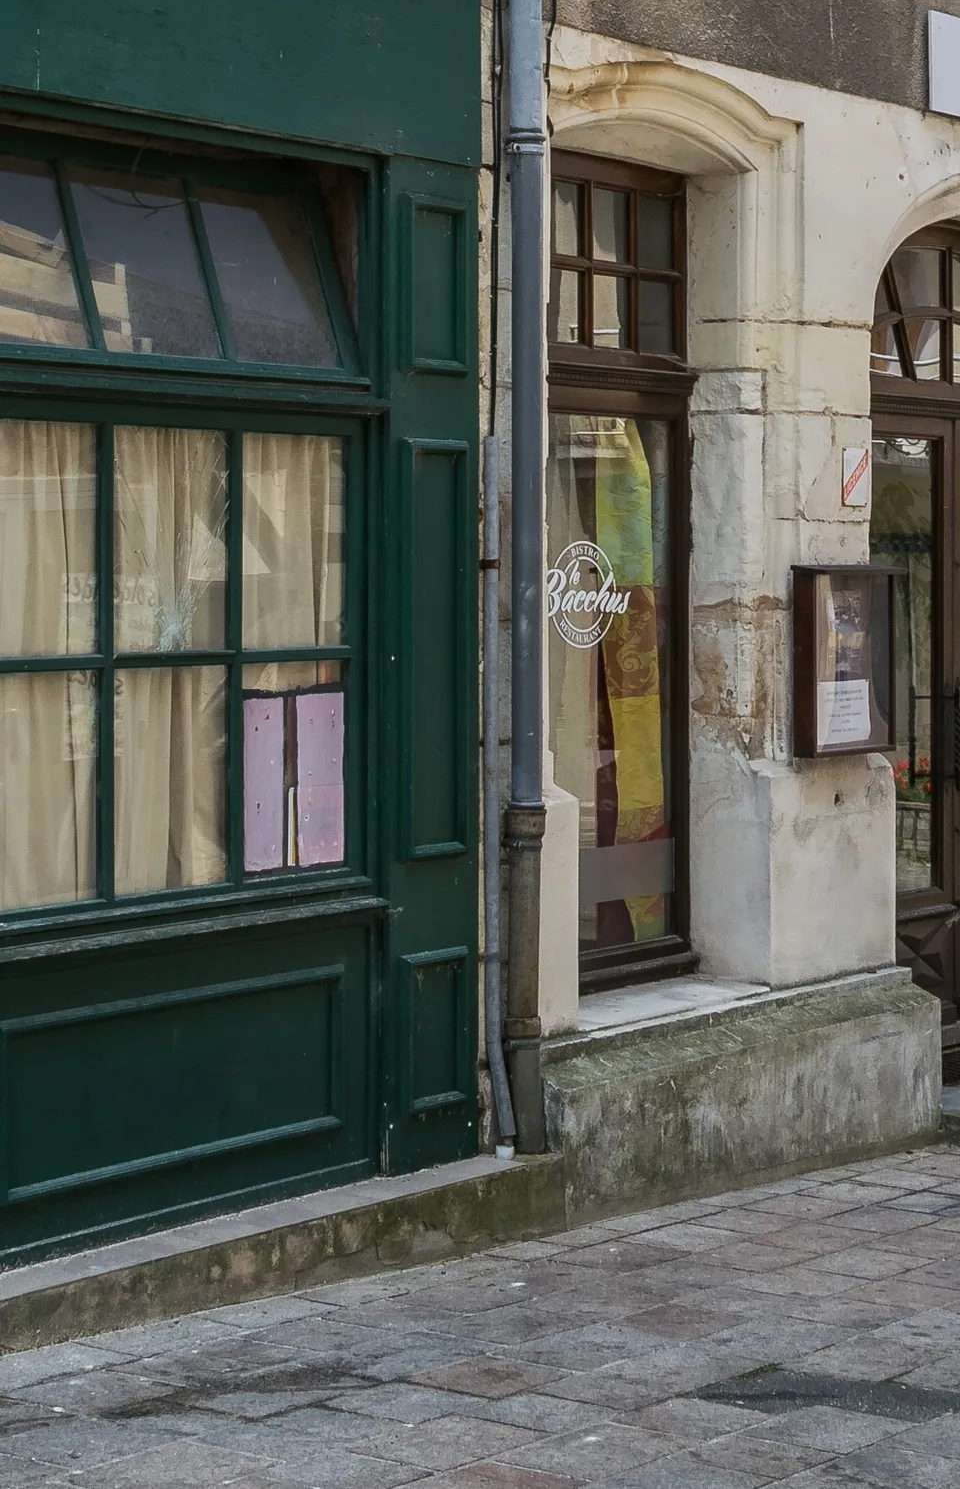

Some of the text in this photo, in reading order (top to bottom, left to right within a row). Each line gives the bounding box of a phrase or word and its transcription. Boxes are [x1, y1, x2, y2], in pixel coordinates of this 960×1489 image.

[570, 545, 600, 561] BISTRO
[569, 560, 581, 585] le
[547, 568, 632, 619] Bacchus
[559, 619, 602, 644] RESTAURANT
